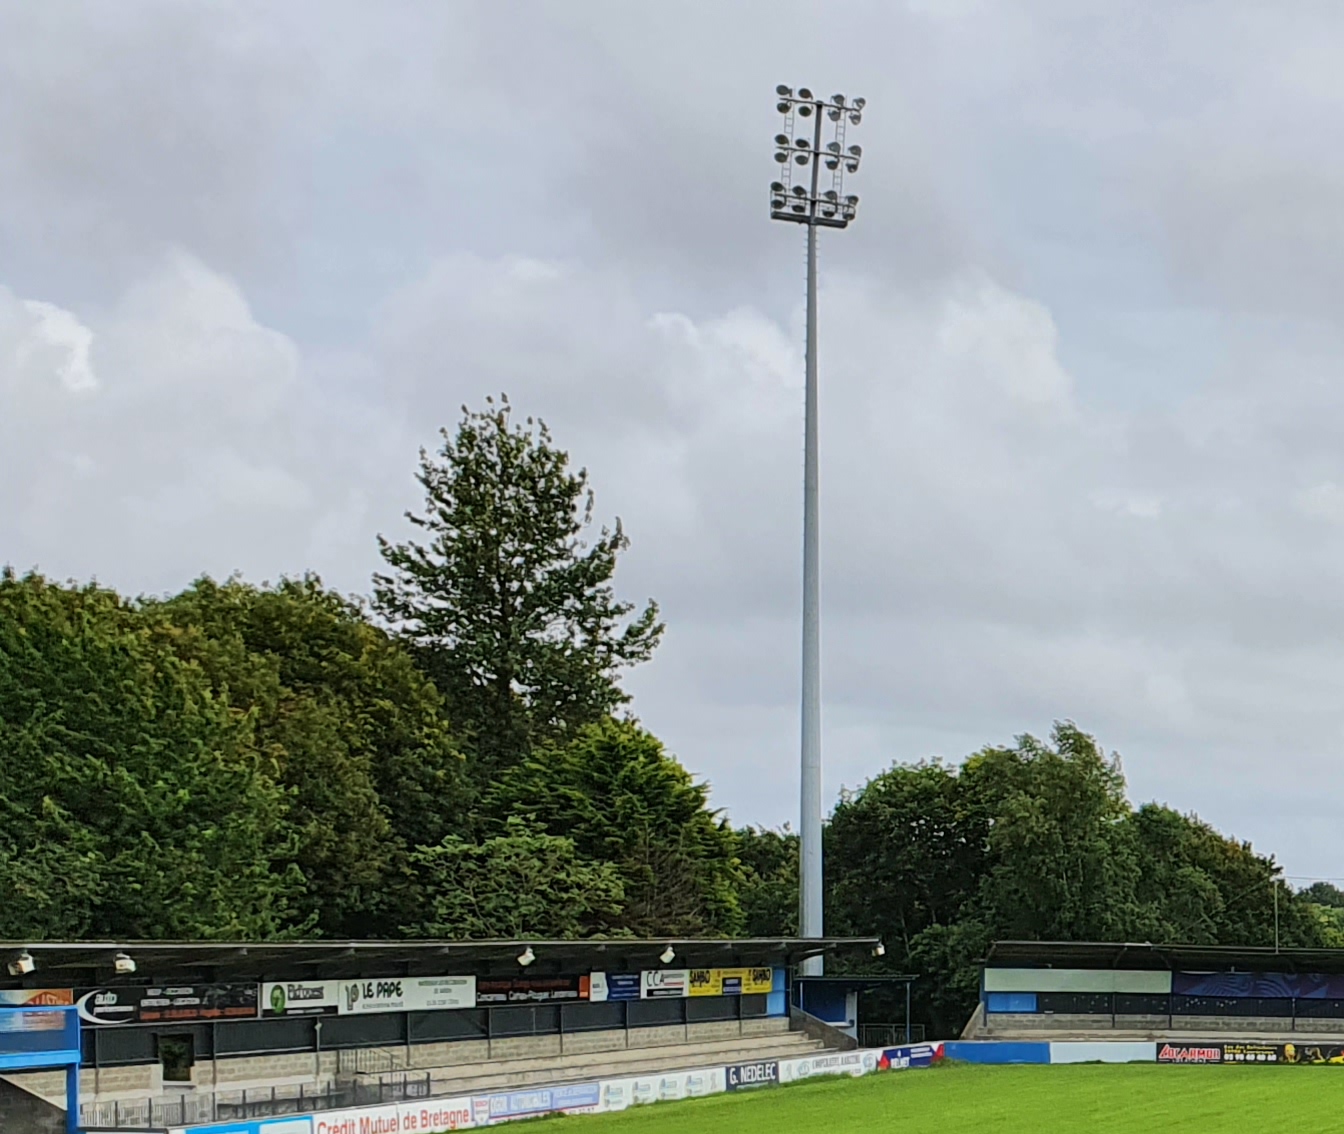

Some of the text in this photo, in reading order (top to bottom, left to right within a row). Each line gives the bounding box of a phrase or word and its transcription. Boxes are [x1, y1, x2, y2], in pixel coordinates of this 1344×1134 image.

[362, 982, 375, 999] LE
[376, 981, 404, 998] PAPE
[740, 1062, 776, 1083] NEDELEC
[403, 1111, 418, 1130] de
[420, 1108, 469, 1130] Bretagne
